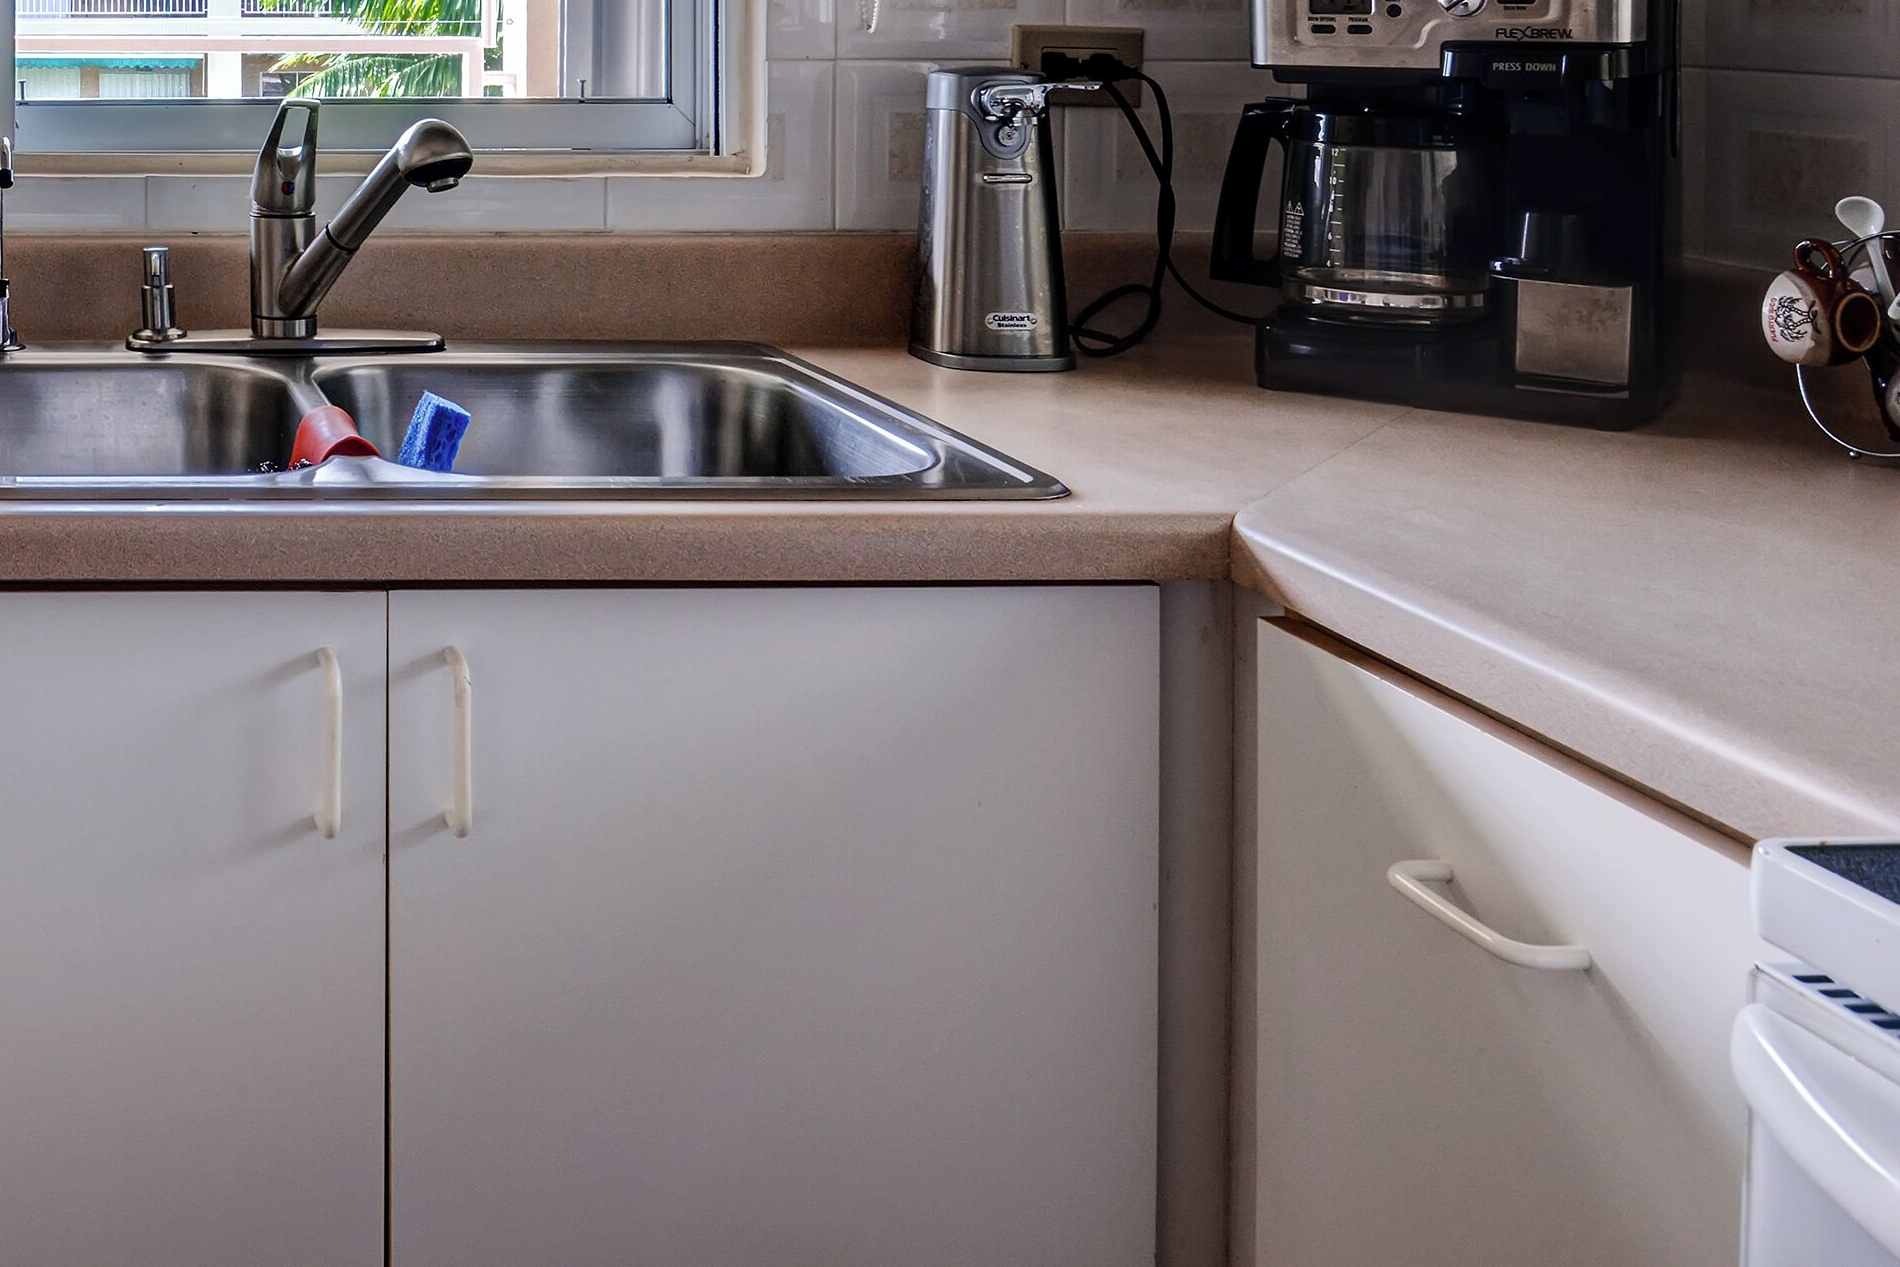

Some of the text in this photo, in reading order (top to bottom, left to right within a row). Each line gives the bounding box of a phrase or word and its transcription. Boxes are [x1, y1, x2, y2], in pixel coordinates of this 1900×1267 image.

[1492, 61, 1556, 72] PRESS DOWN
[992, 314, 1031, 322] Cuisinart
[1768, 315, 1780, 342] PUERTO
